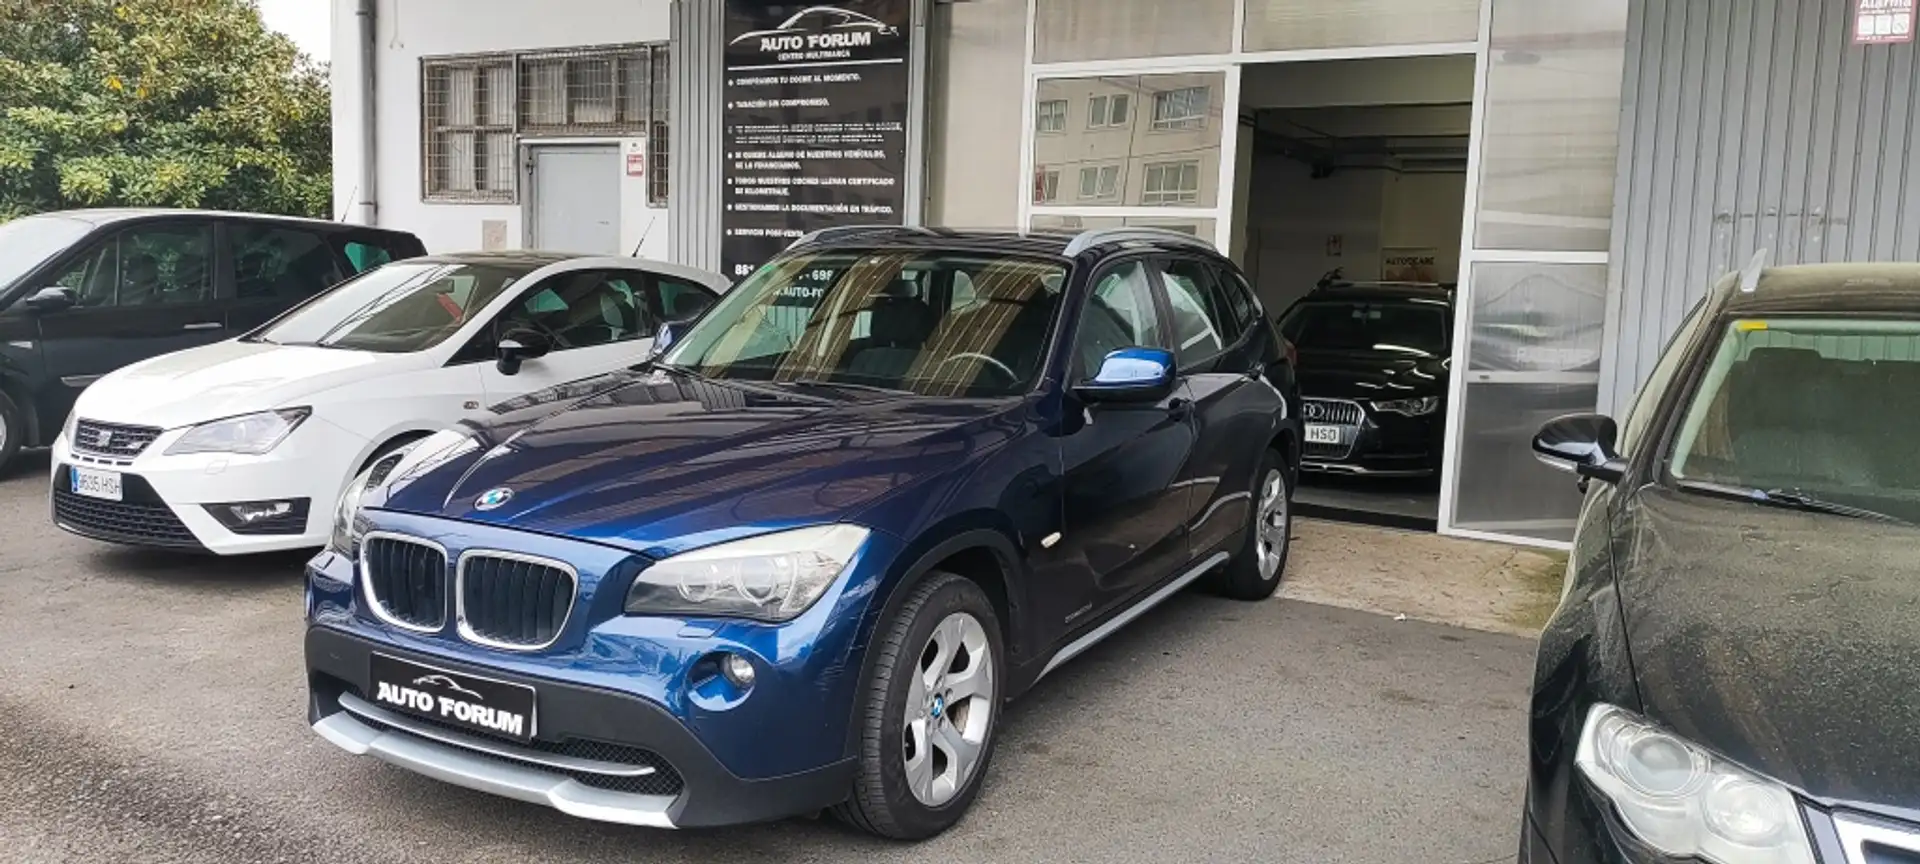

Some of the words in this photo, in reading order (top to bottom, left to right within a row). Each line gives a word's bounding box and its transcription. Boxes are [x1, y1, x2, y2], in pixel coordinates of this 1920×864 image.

[760, 35, 803, 51] AUTO
[807, 32, 871, 48] FORUM
[778, 53, 804, 61] CENTRO
[805, 49, 851, 59] MULTIMARCA
[847, 177, 895, 185] CERTIFICADO
[377, 681, 434, 711] AUTO
[438, 696, 524, 736] FORUM
